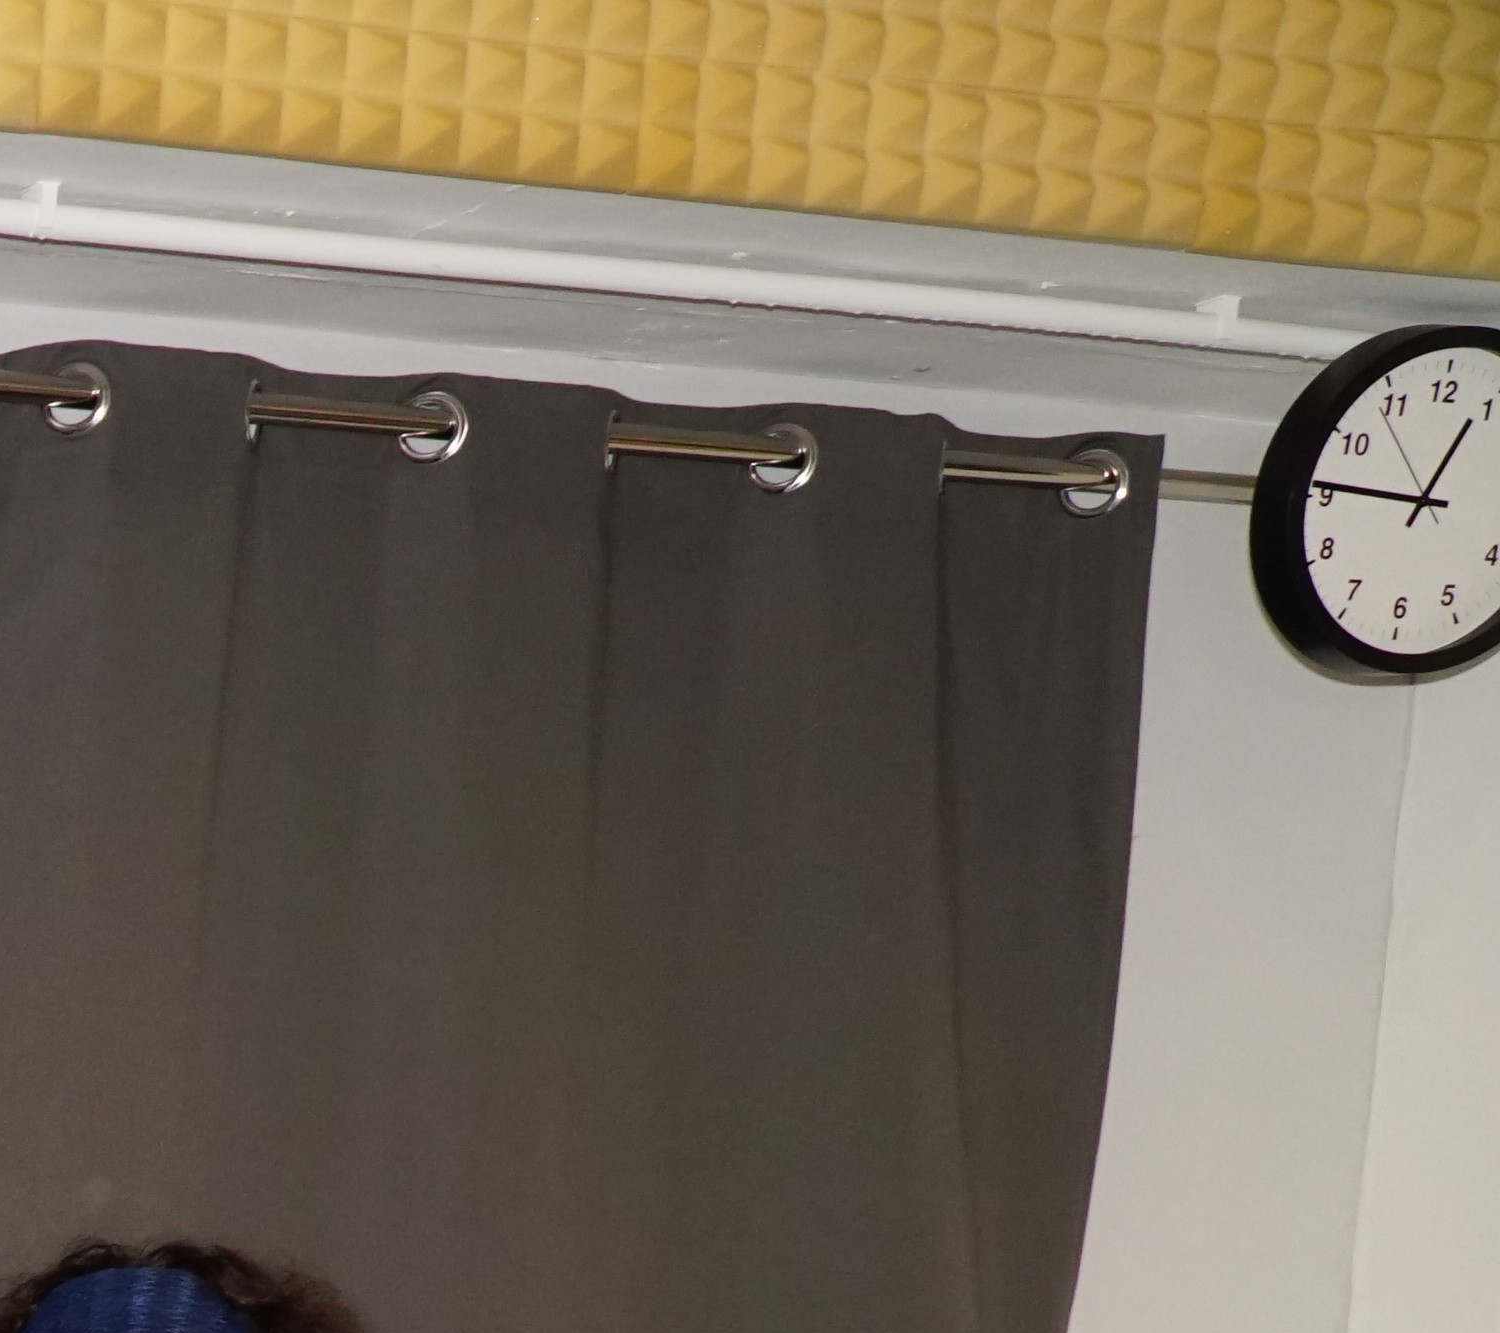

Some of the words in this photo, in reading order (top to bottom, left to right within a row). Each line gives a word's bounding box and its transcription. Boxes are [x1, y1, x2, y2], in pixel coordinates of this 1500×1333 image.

[1430, 380, 1459, 404] 12
[1382, 393, 1408, 417] 11
[1481, 398, 1494, 421] 1
[1341, 432, 1370, 456] 10
[1319, 487, 1334, 507] 9
[1319, 537, 1335, 560] 8
[1484, 544, 1499, 567] 4
[1347, 579, 1363, 602] 7
[1440, 584, 1456, 607] 5
[1392, 596, 1408, 620] 6
